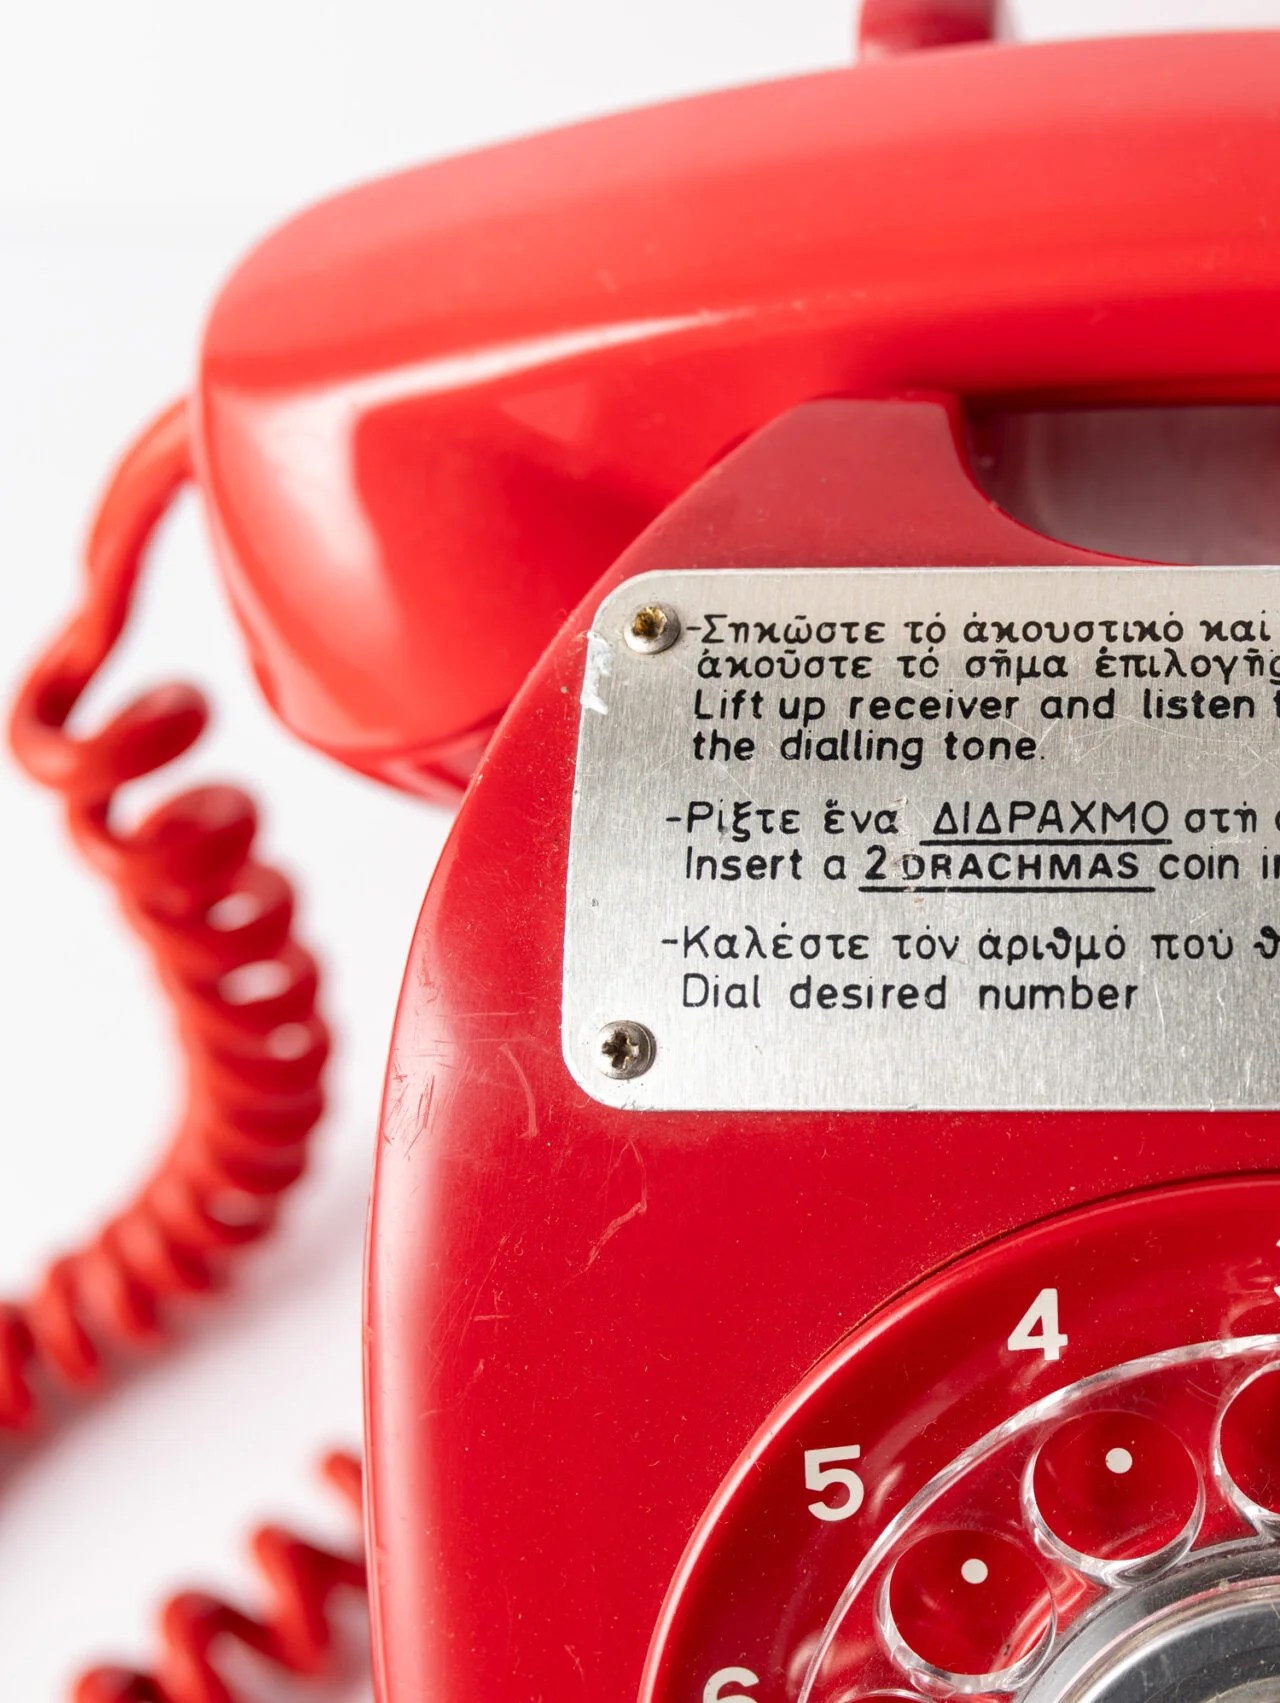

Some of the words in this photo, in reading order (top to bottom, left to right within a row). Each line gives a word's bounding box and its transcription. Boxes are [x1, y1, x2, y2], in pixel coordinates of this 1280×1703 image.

[695, 688, 764, 720] Lift
[779, 696, 826, 728] up
[849, 688, 1020, 720] receiver
[1040, 688, 1116, 720] and
[1143, 688, 1255, 720] listen
[693, 729, 756, 761] the
[780, 729, 924, 771] dialling
[944, 731, 1046, 761] tone.
[933, 800, 1168, 835] ΔΙΔΡΑΧΜΟ
[686, 845, 803, 881] Insert
[824, 855, 847, 881] a
[864, 845, 888, 881] 2
[902, 852, 1139, 880] DRACHMAS
[1159, 846, 1240, 880] coin
[683, 973, 761, 1009] Dial
[789, 975, 947, 1010] desired
[979, 975, 1138, 1010] number
[1008, 1289, 1067, 1361] 4
[805, 1445, 863, 1521] 5
